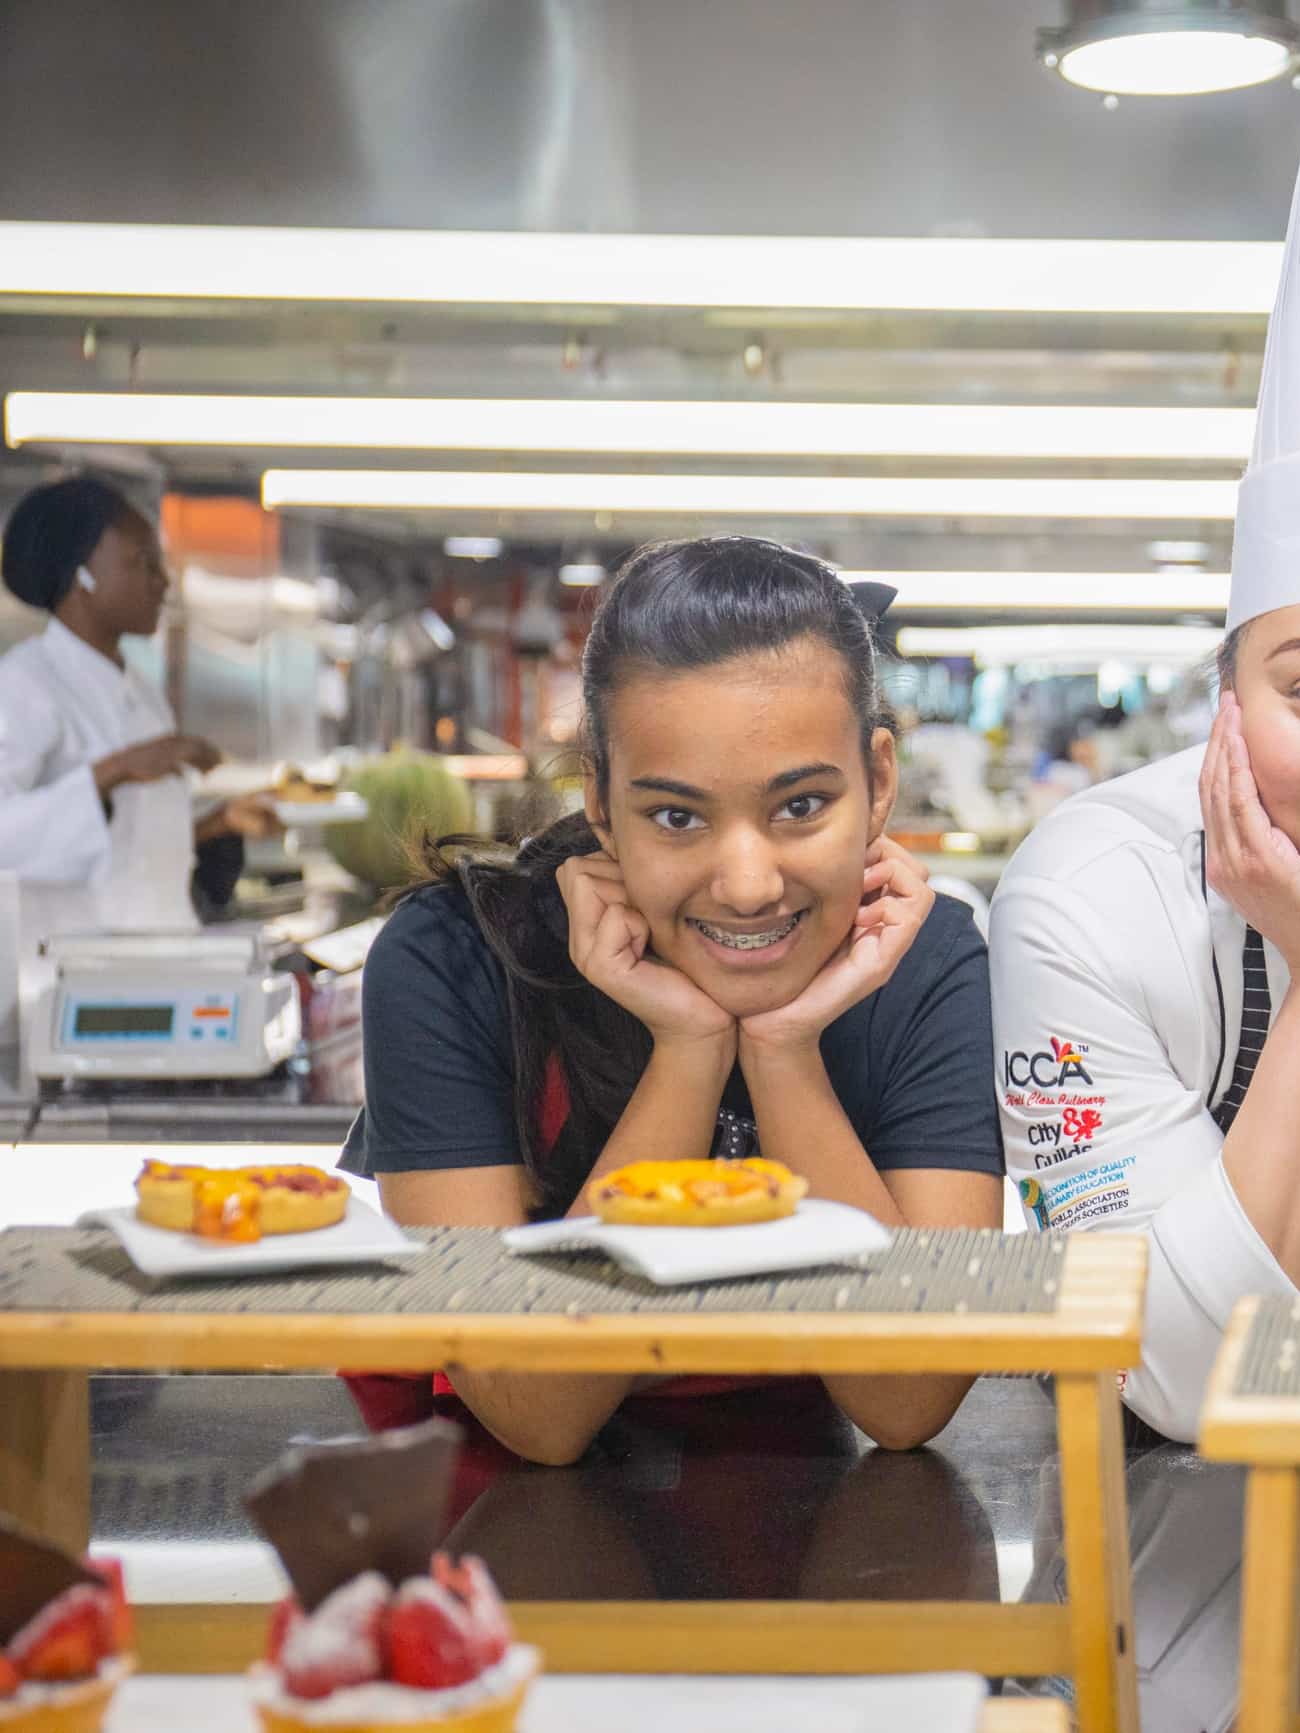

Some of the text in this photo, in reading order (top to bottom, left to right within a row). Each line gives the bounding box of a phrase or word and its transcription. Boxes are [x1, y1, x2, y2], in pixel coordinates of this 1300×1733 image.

[1005, 1050, 1094, 1087] ICCA
[1028, 1122, 1062, 1146] City
[1074, 1188, 1129, 1215] ASSOCIATION
